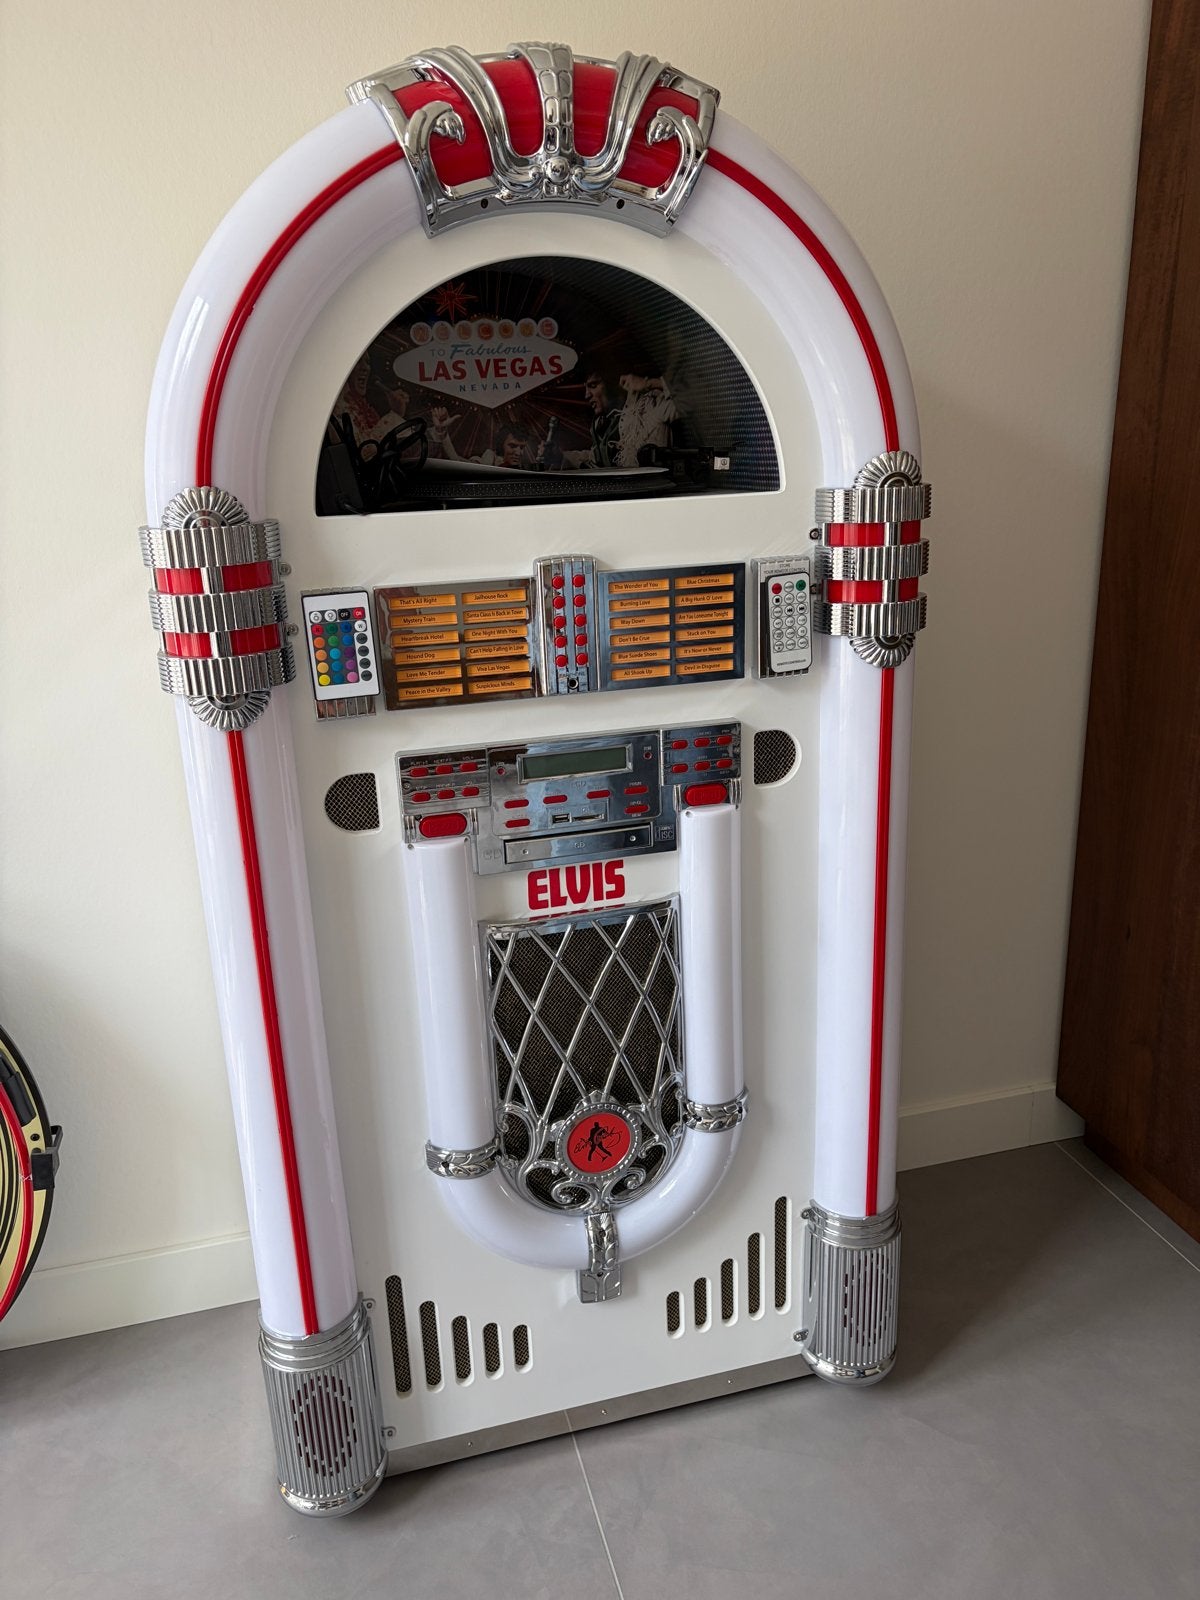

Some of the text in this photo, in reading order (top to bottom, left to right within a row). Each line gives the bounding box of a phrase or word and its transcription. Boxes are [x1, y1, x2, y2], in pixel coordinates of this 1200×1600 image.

[413, 319, 556, 342] WELCOME
[430, 342, 532, 360] TO Fabulous
[417, 355, 564, 382] LAS VEGAS
[458, 381, 522, 393] NEVADA
[527, 859, 626, 911] ELVIS
